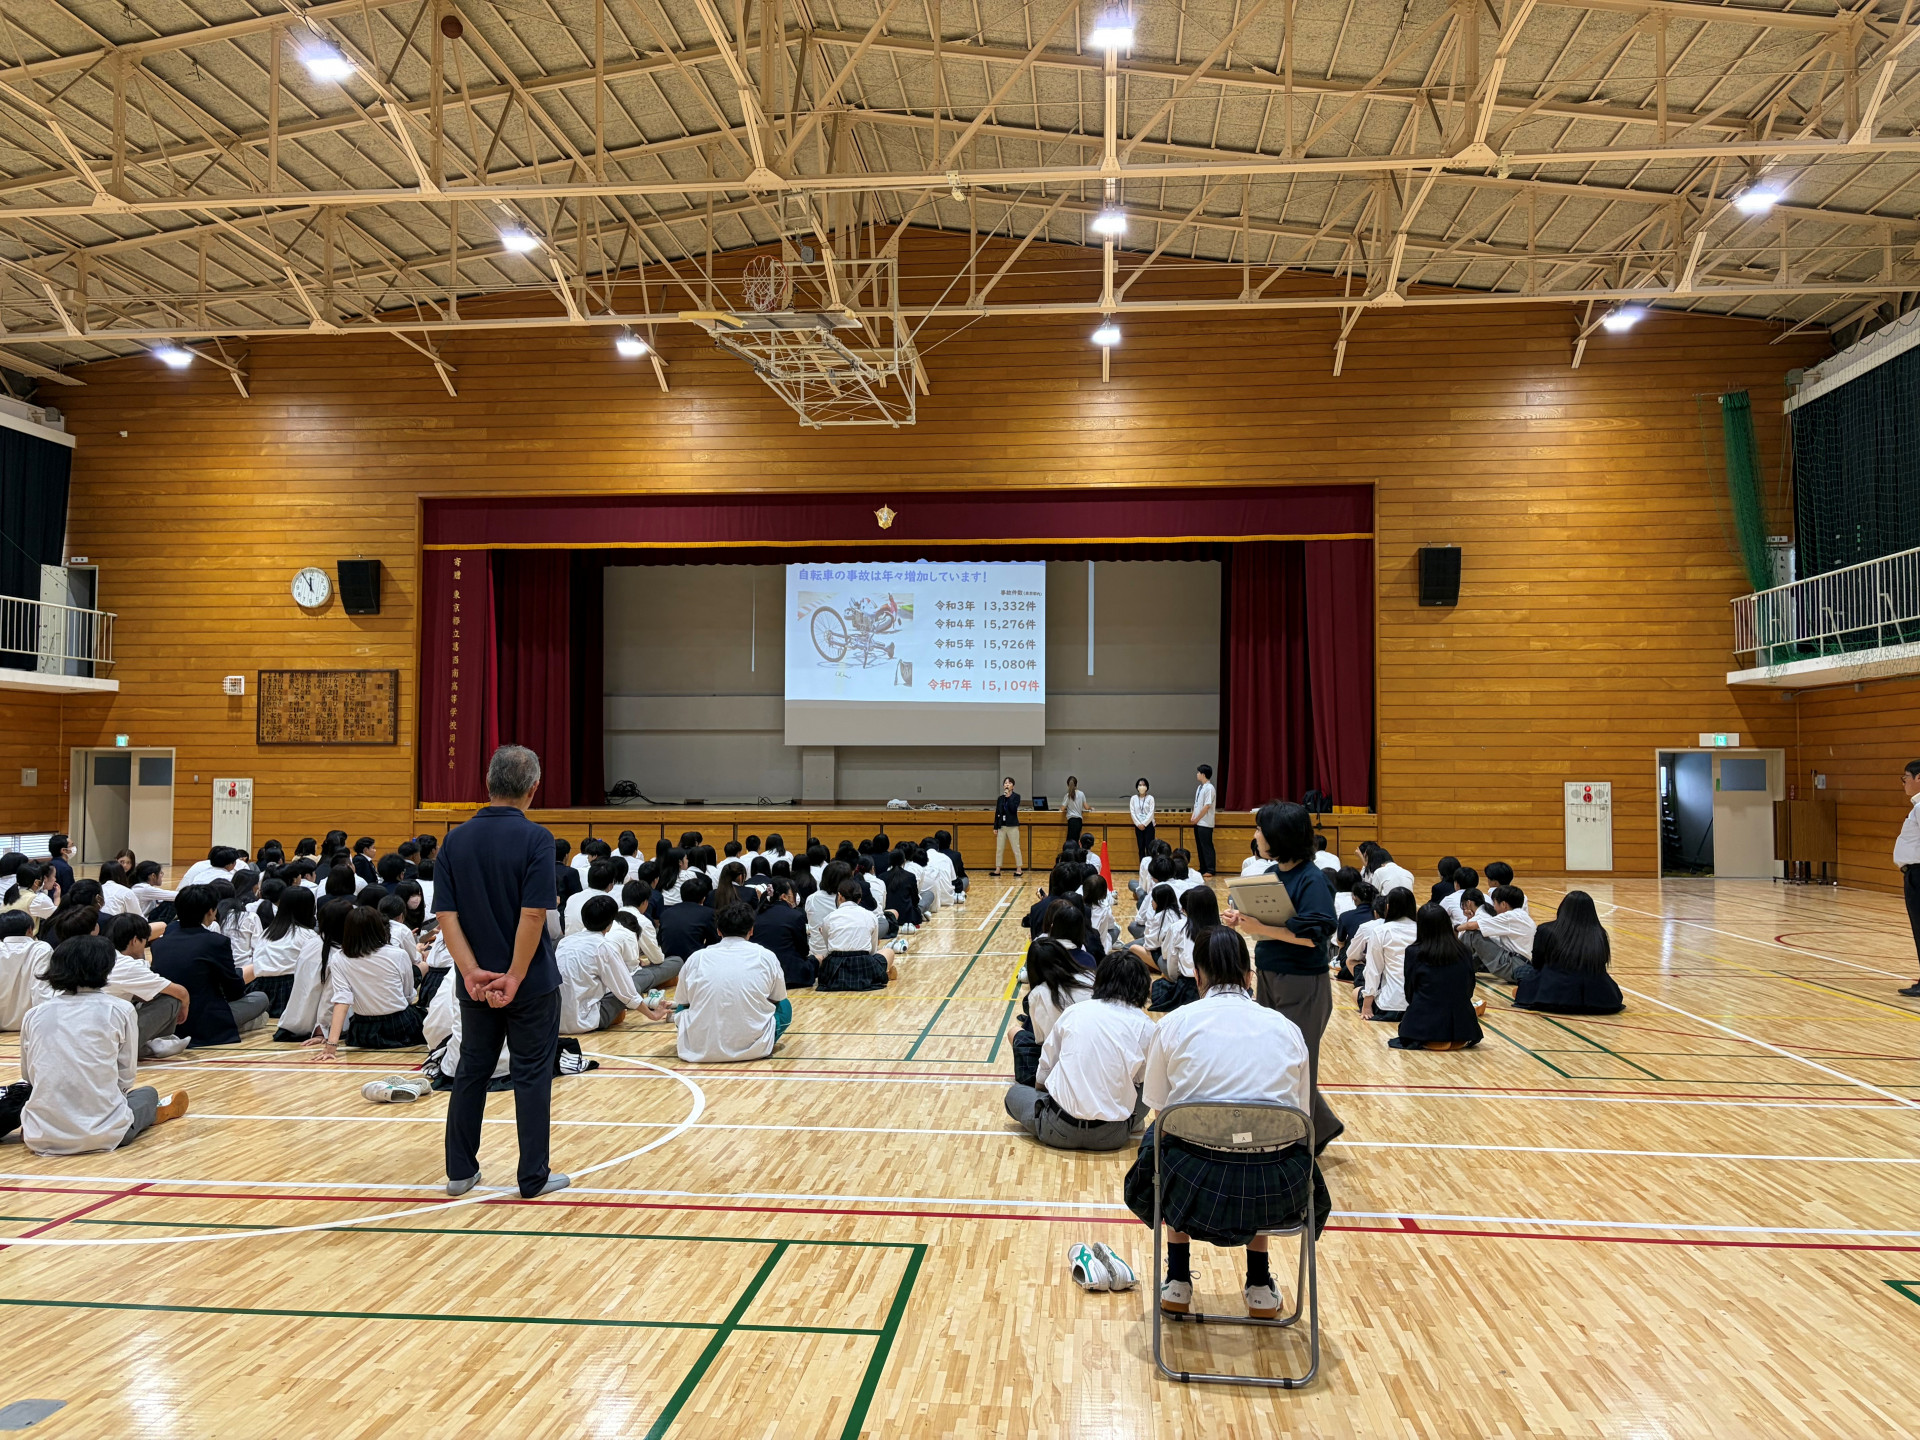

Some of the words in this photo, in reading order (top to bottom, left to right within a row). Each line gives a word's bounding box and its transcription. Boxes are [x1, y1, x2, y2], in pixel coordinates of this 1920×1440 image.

[799, 568, 987, 583] 自転車の事故は年々増加しています!
[935, 600, 975, 611] 令和3年
[984, 601, 1036, 612] 13,332件
[935, 619, 975, 629] 令和4年
[984, 619, 1036, 630] 15,276件
[934, 638, 975, 649] 令和5年
[984, 639, 1036, 650] 15,926件
[934, 658, 974, 669] 令和6年
[984, 659, 1037, 670] 15,080件
[928, 679, 972, 691] 令和7年
[982, 680, 1040, 692] 15,109件
